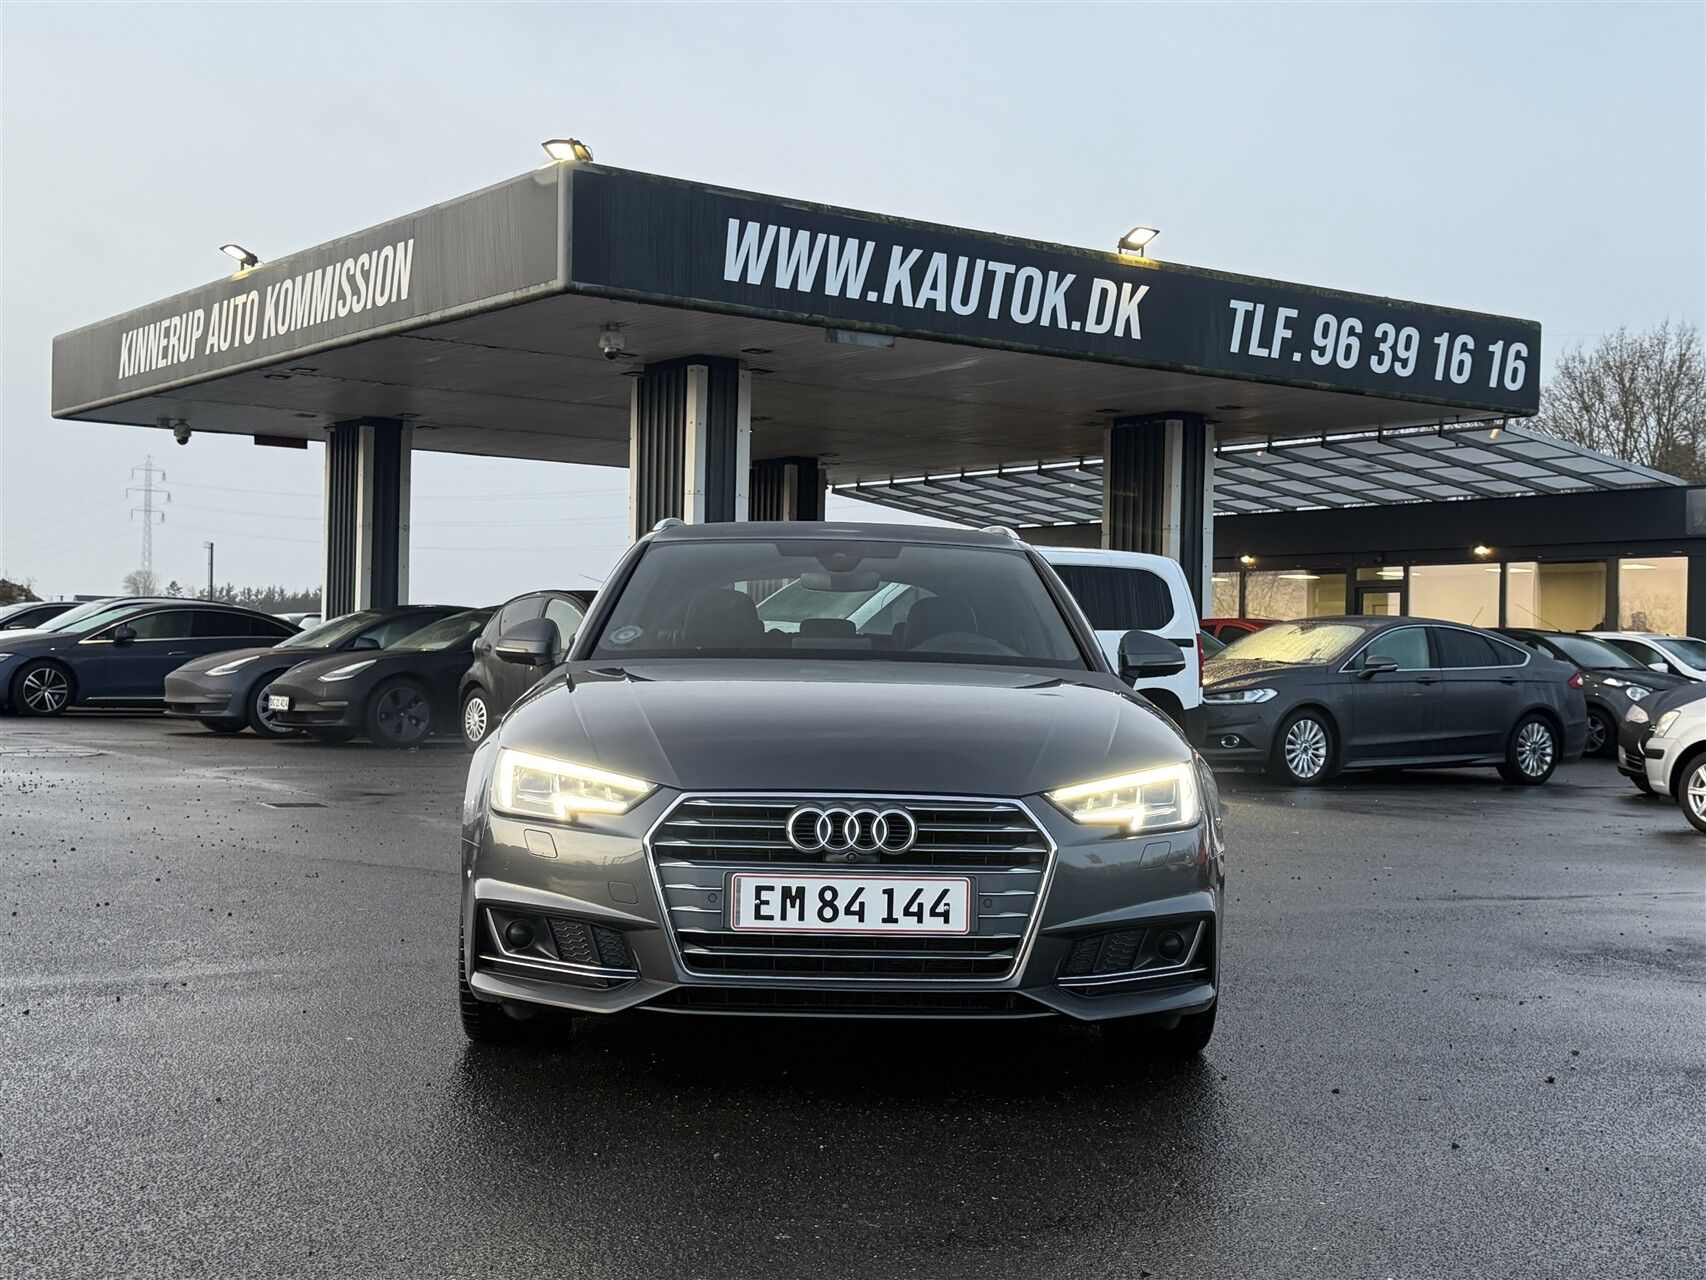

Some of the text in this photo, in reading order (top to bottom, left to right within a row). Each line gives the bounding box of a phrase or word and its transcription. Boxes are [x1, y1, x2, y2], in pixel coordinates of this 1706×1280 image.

[118, 238, 415, 380] KINNERUP AUTO KOMMISSION
[723, 217, 1150, 341] WWW.KAUTOK.DK
[1229, 299, 1529, 391] TLF. 96 39 16 16
[753, 884, 951, 925] EM 84 144
